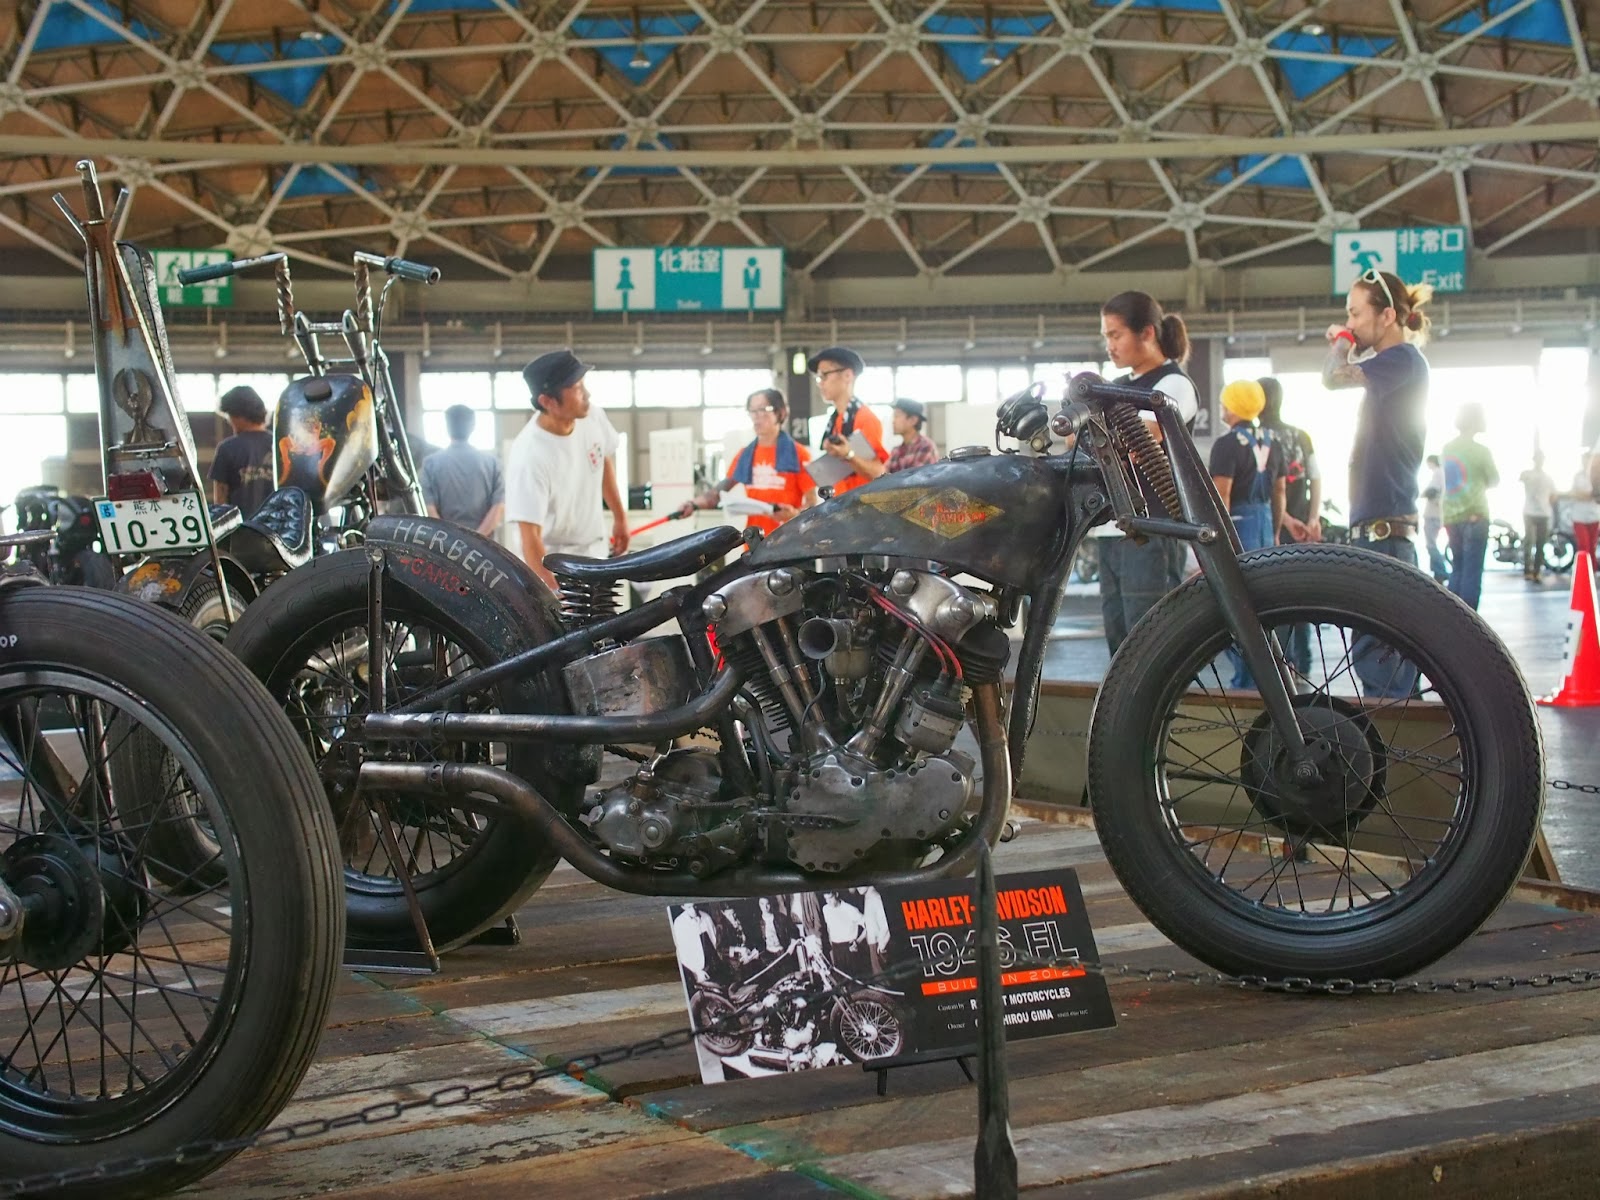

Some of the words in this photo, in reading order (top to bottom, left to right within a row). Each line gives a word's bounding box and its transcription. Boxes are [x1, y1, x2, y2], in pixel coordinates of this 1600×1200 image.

[1398, 228, 1464, 254] 非常口
[1422, 269, 1464, 290] Exit
[182, 496, 195, 511] な
[110, 515, 202, 550] 10-39
[393, 519, 509, 589] HERBERT
[901, 885, 1068, 931] HARLEY-AVIDSON
[1022, 920, 1080, 960] FL
[937, 979, 978, 992] BUIL
[1010, 986, 1071, 1006] MOTORCYCLES
[1030, 1008, 1054, 1022] GIMA
